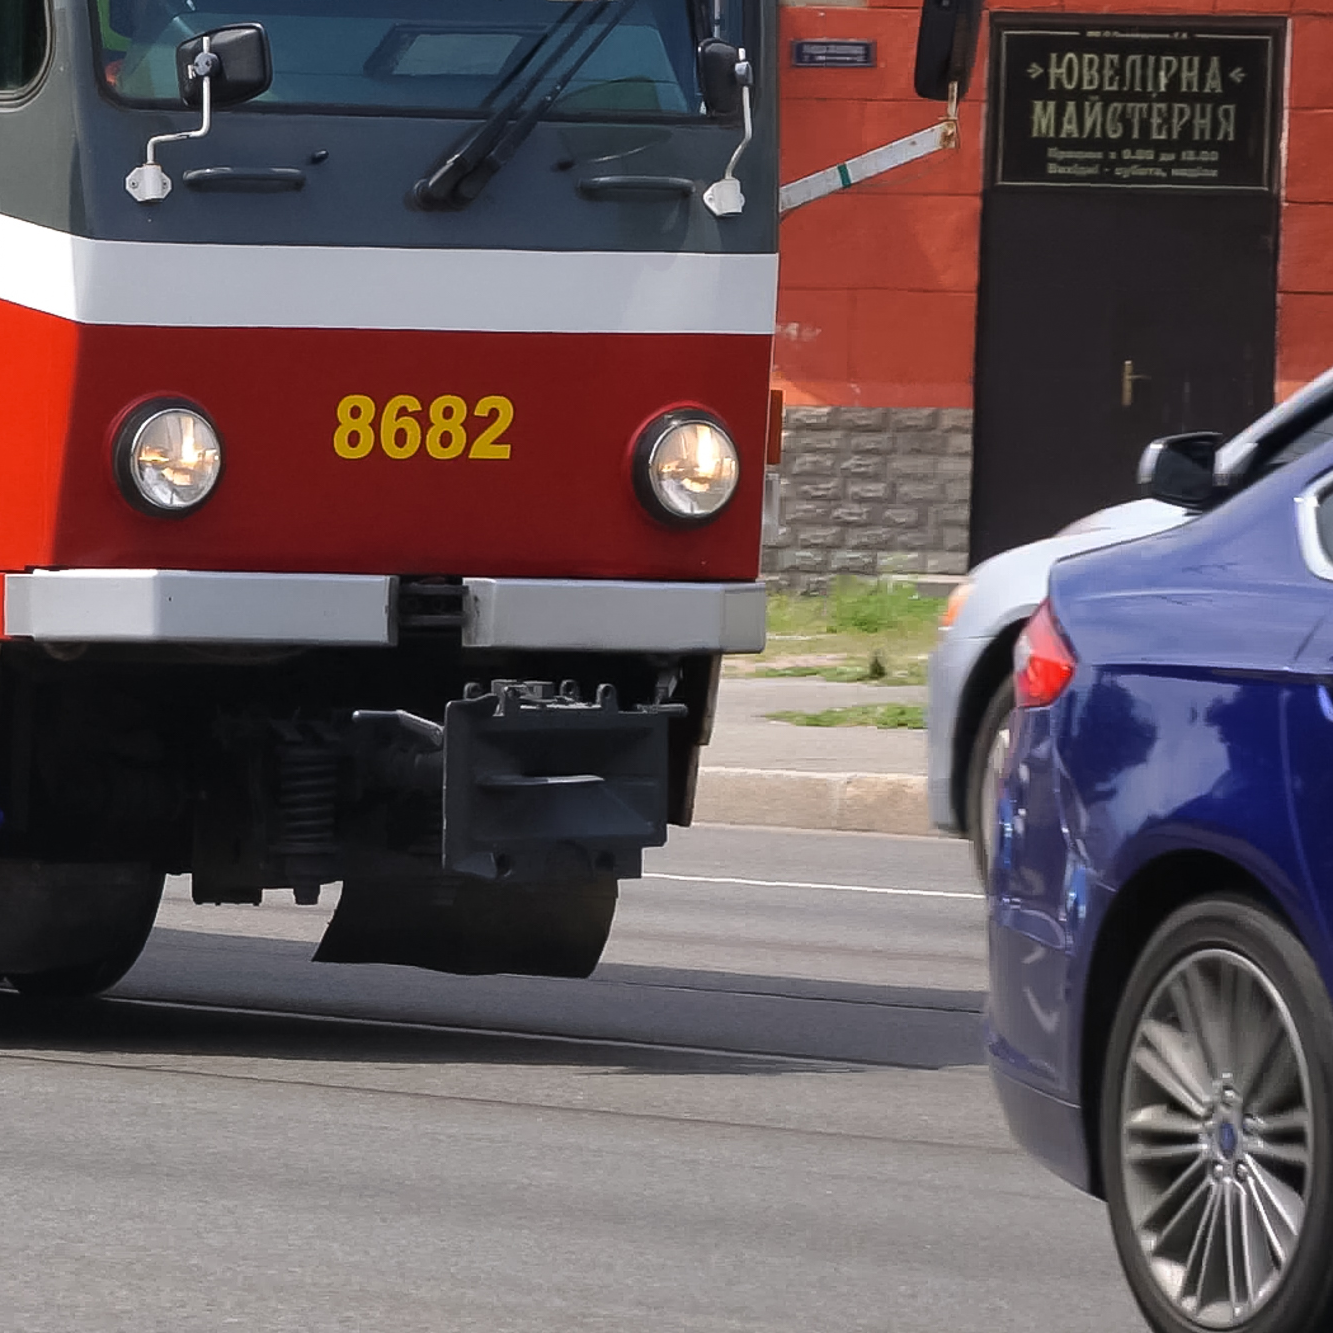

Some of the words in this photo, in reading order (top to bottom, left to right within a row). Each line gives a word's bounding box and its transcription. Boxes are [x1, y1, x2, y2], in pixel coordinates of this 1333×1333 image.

[1047, 52, 1224, 93] ЮВЕЛІРНА
[1032, 95, 1236, 141] МАЙСТЕРНЯ
[333, 394, 514, 460] 8682
